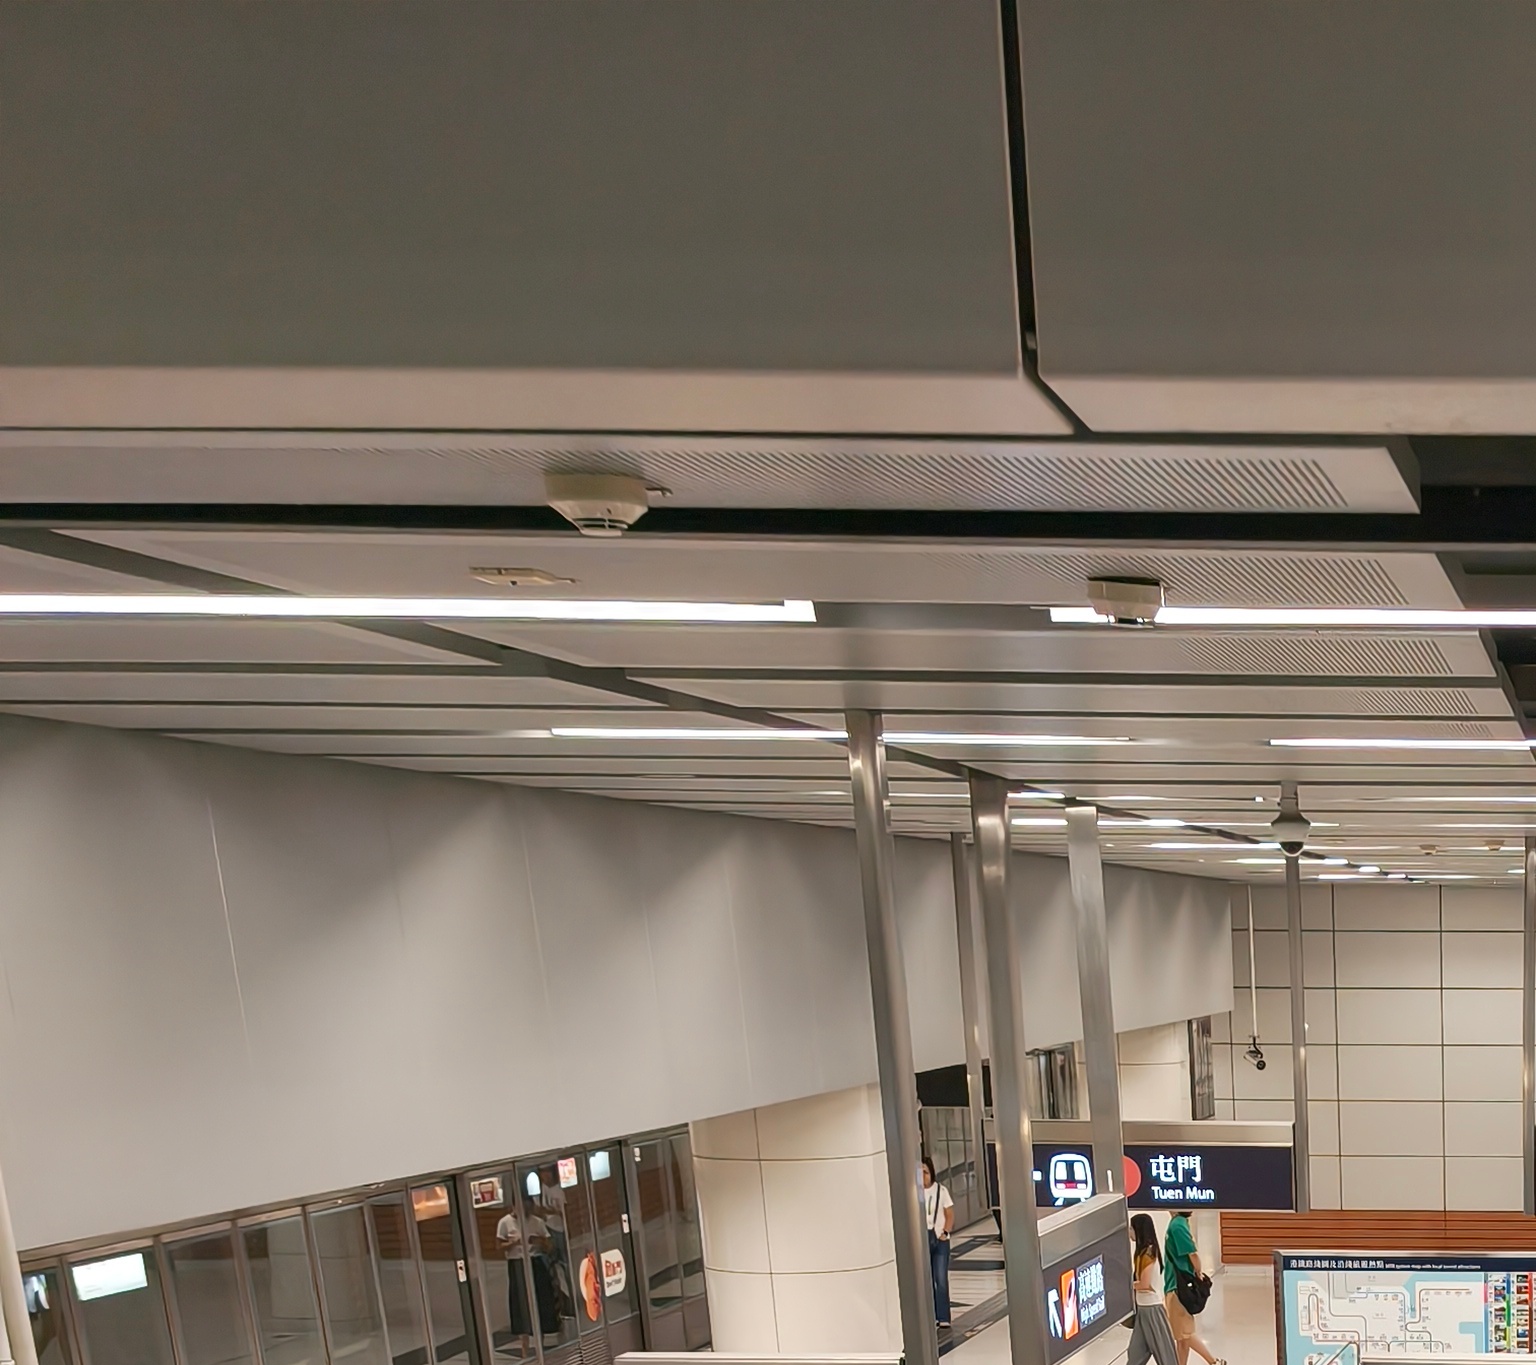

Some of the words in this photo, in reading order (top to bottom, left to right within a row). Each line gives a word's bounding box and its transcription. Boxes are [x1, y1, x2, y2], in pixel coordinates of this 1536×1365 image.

[1149, 1154, 1202, 1183] 屯門
[1151, 1186, 1183, 1200] Tuen
[1186, 1186, 1215, 1200] Mun
